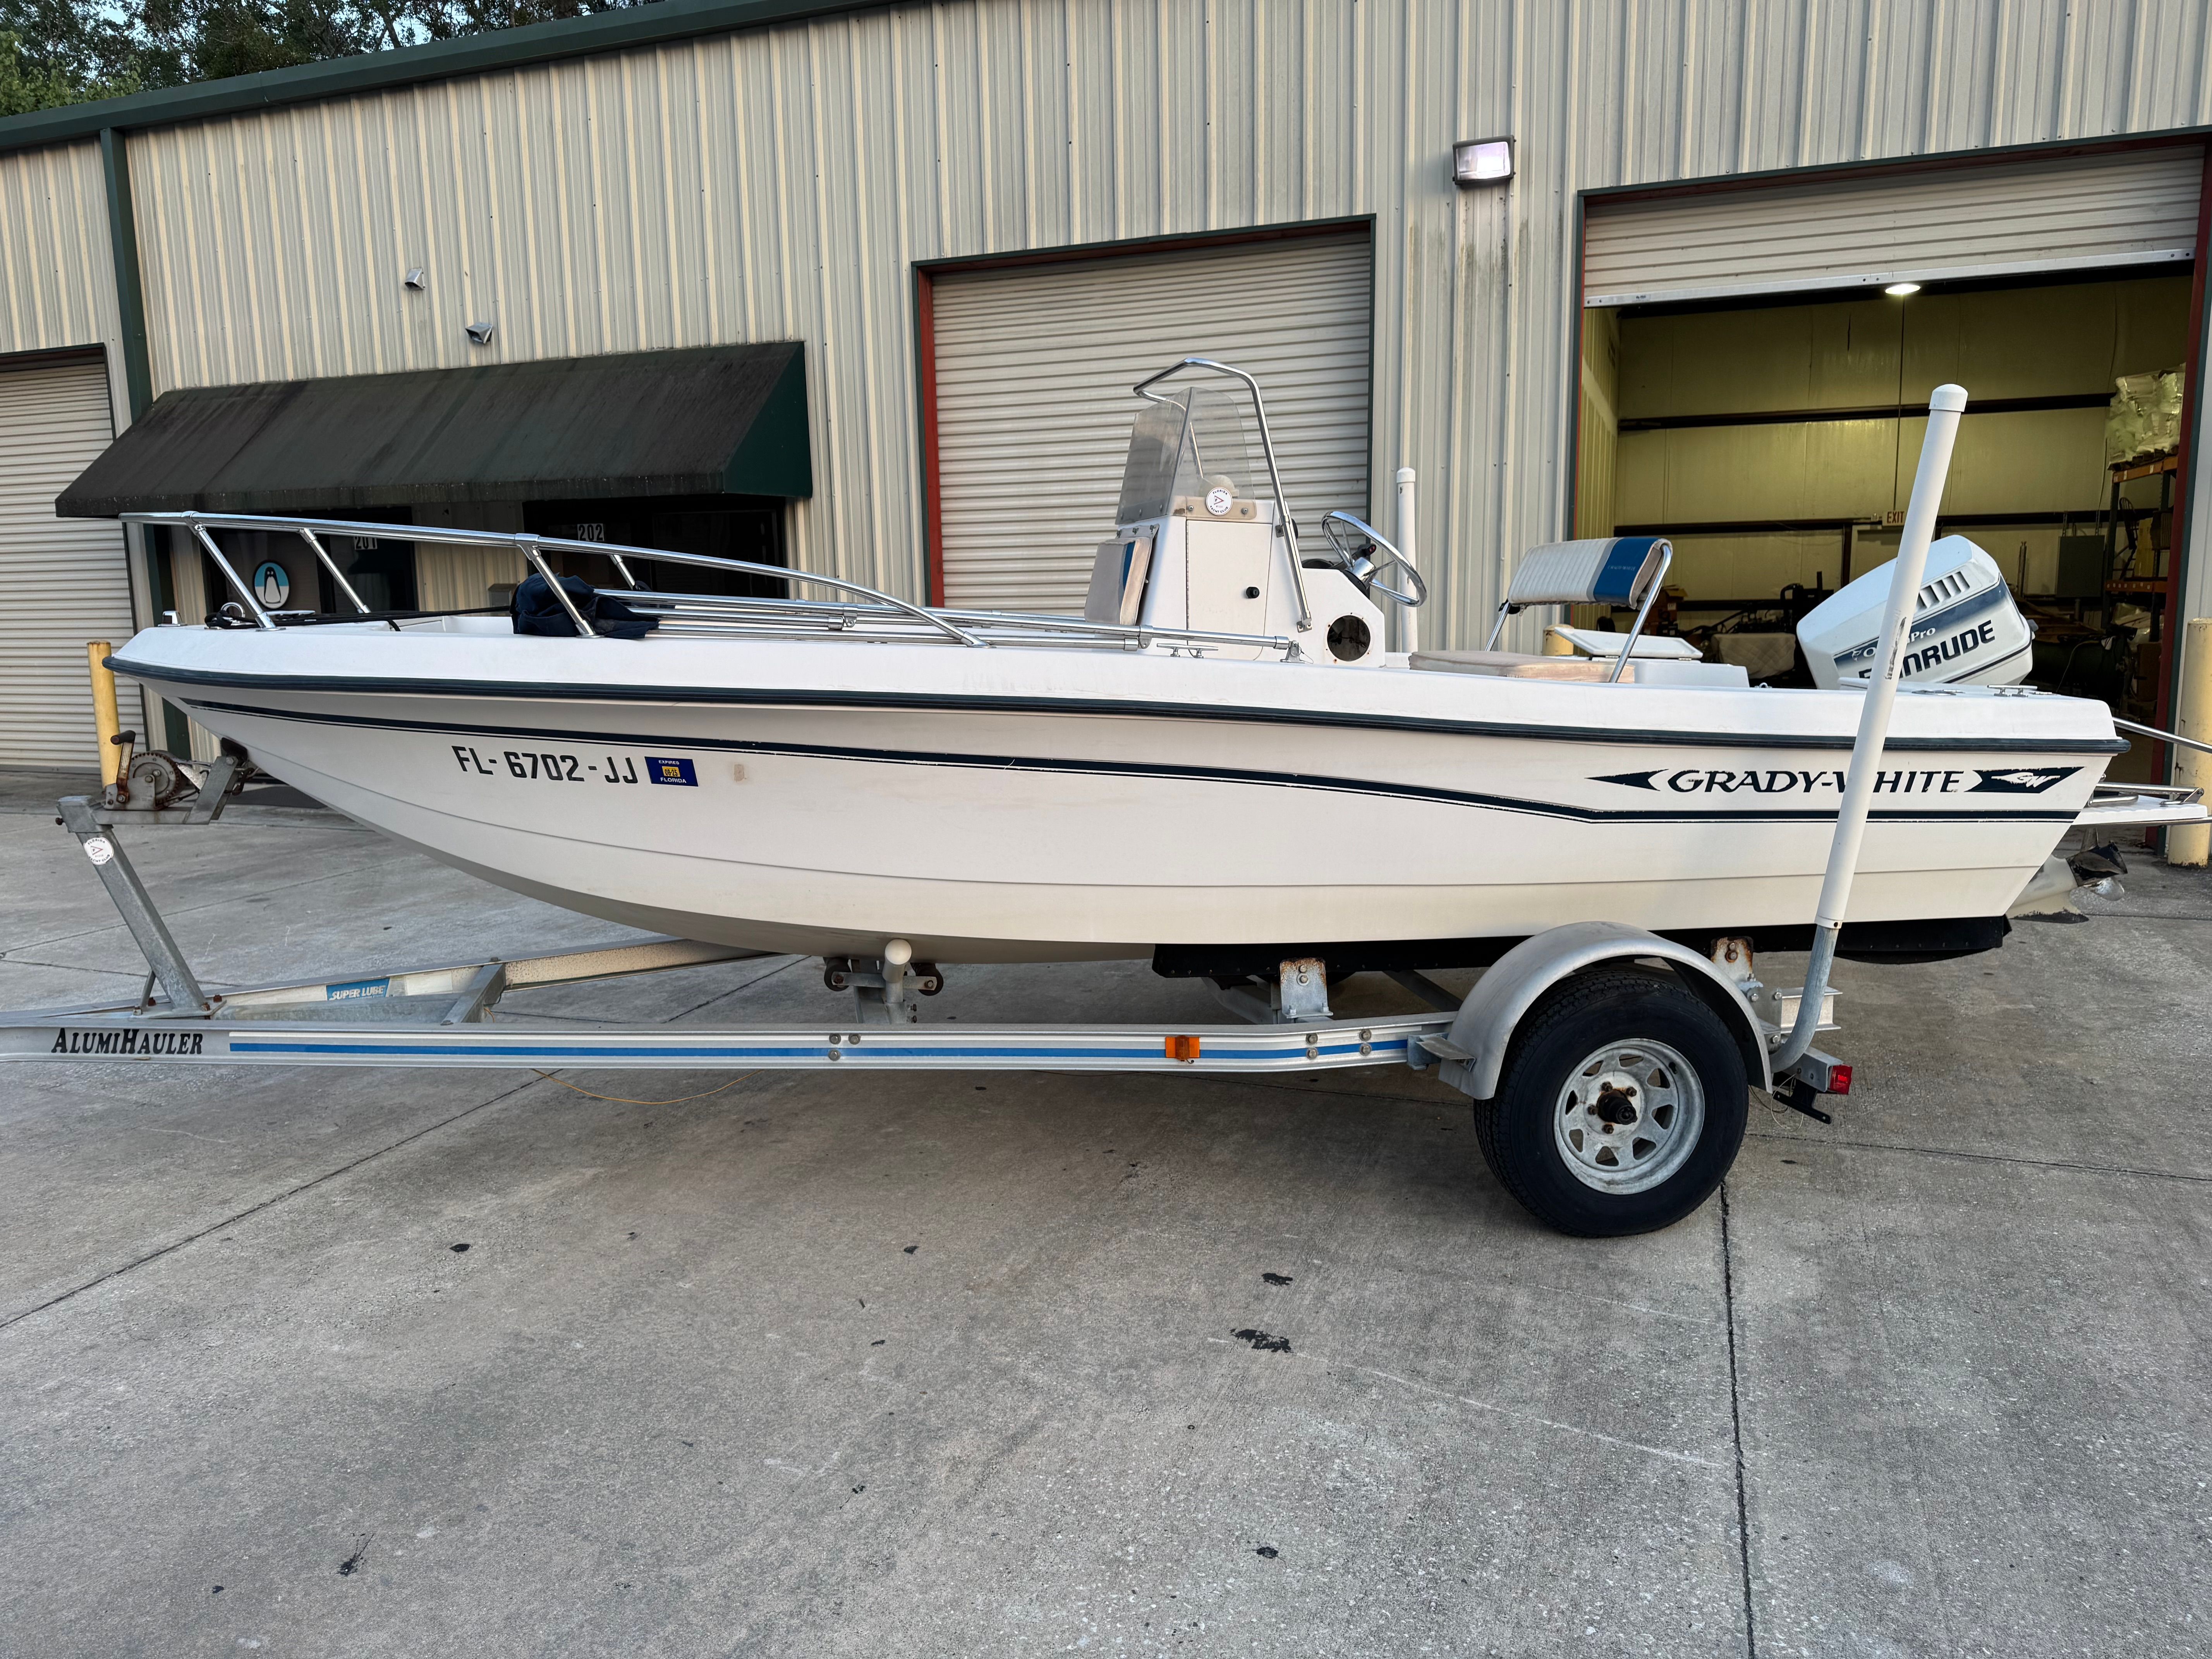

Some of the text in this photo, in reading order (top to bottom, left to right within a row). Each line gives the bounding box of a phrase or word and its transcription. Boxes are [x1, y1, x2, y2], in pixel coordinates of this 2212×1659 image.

[1210, 505, 1219, 513] YACHT
[1887, 511, 1905, 524] EXIT
[579, 524, 603, 541] 202
[354, 536, 376, 549] 201
[329, 985, 386, 1001] SUPER LUBE
